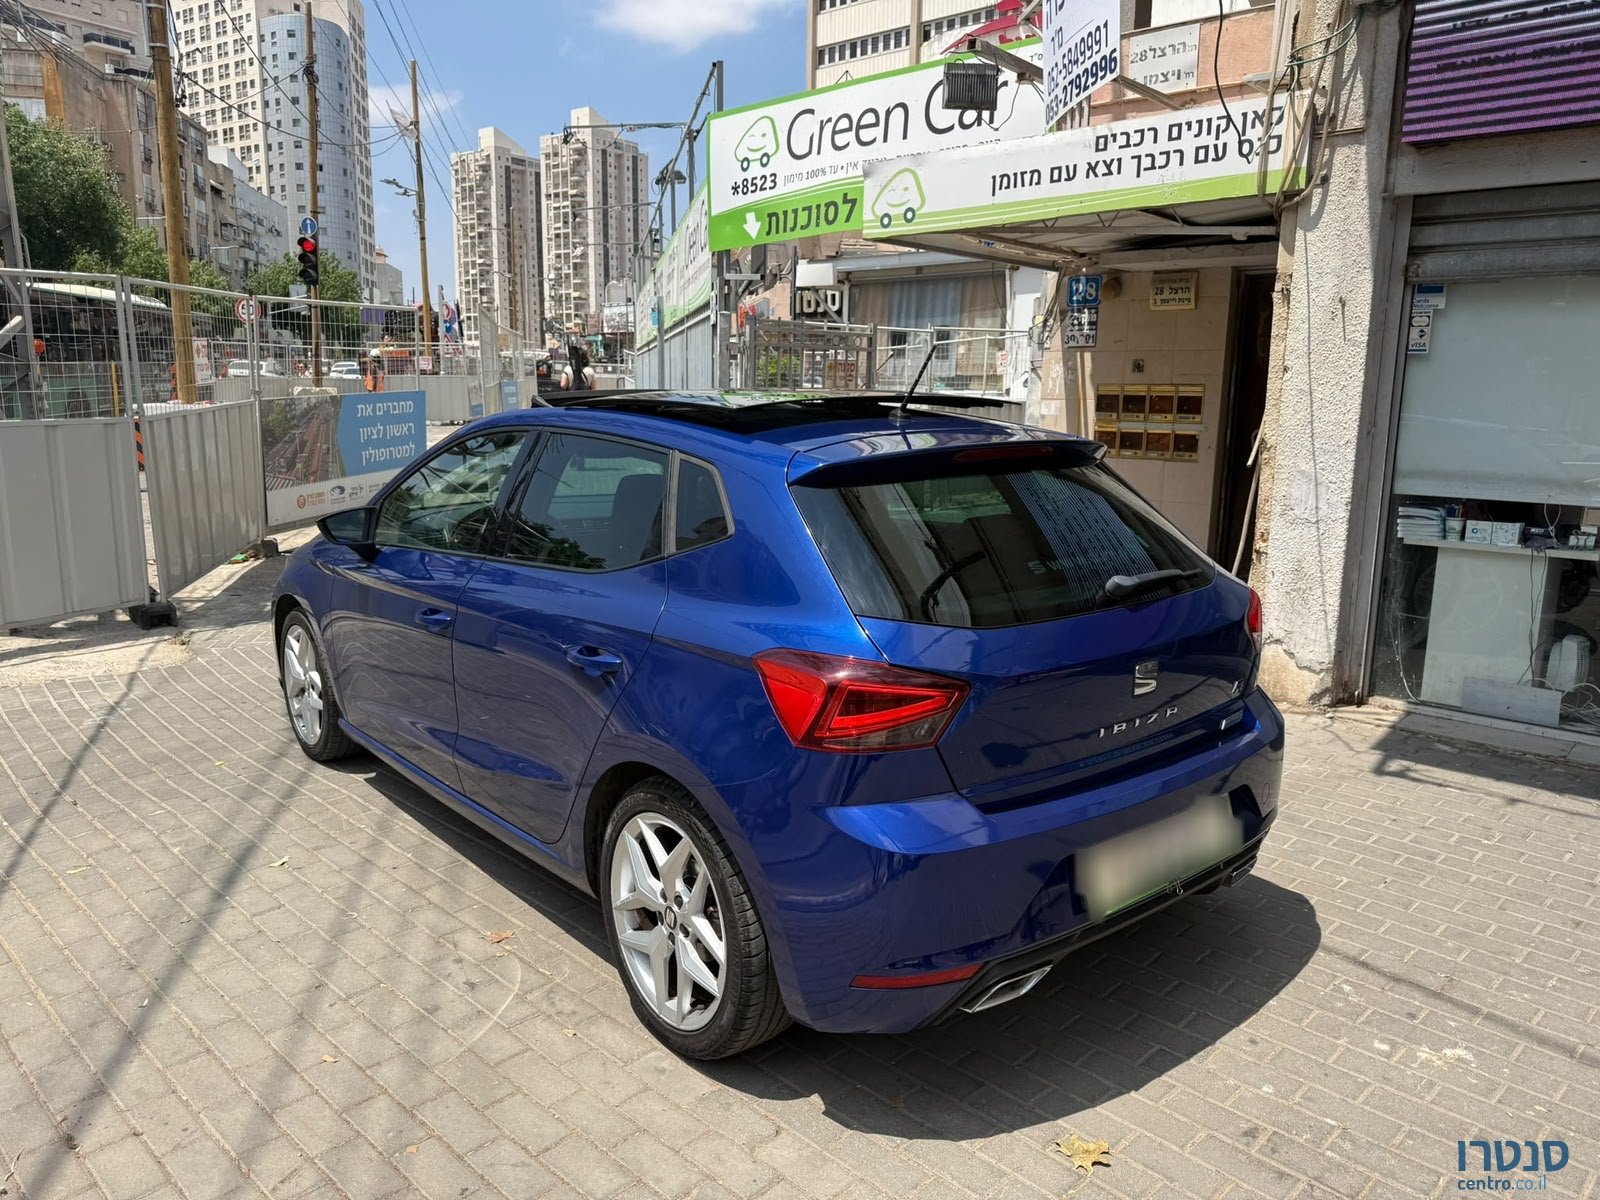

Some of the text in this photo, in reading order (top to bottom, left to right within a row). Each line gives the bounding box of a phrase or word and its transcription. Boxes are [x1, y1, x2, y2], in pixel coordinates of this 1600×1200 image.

[1047, 19, 1108, 97] 052-5849991
[1045, 48, 1118, 126] 053-2792996
[786, 78, 1009, 161] Green Car
[1168, 114, 1232, 142] קונים
[1095, 127, 1158, 153] רכבים
[1194, 139, 1227, 165] עם
[805, 162, 827, 180] 100%
[1049, 162, 1077, 185] עם
[1085, 156, 1122, 180] וצא
[1131, 148, 1184, 179] רכבך
[783, 170, 804, 187] מימון
[991, 167, 1042, 197] מזומן
[766, 192, 858, 237] לסוכנות
[1072, 281, 1097, 301] 28
[357, 400, 414, 417] מחברים את
[359, 422, 415, 443] ראשון לציון
[361, 443, 416, 467] למטרופולין
[1098, 706, 1179, 739] IBIZA
